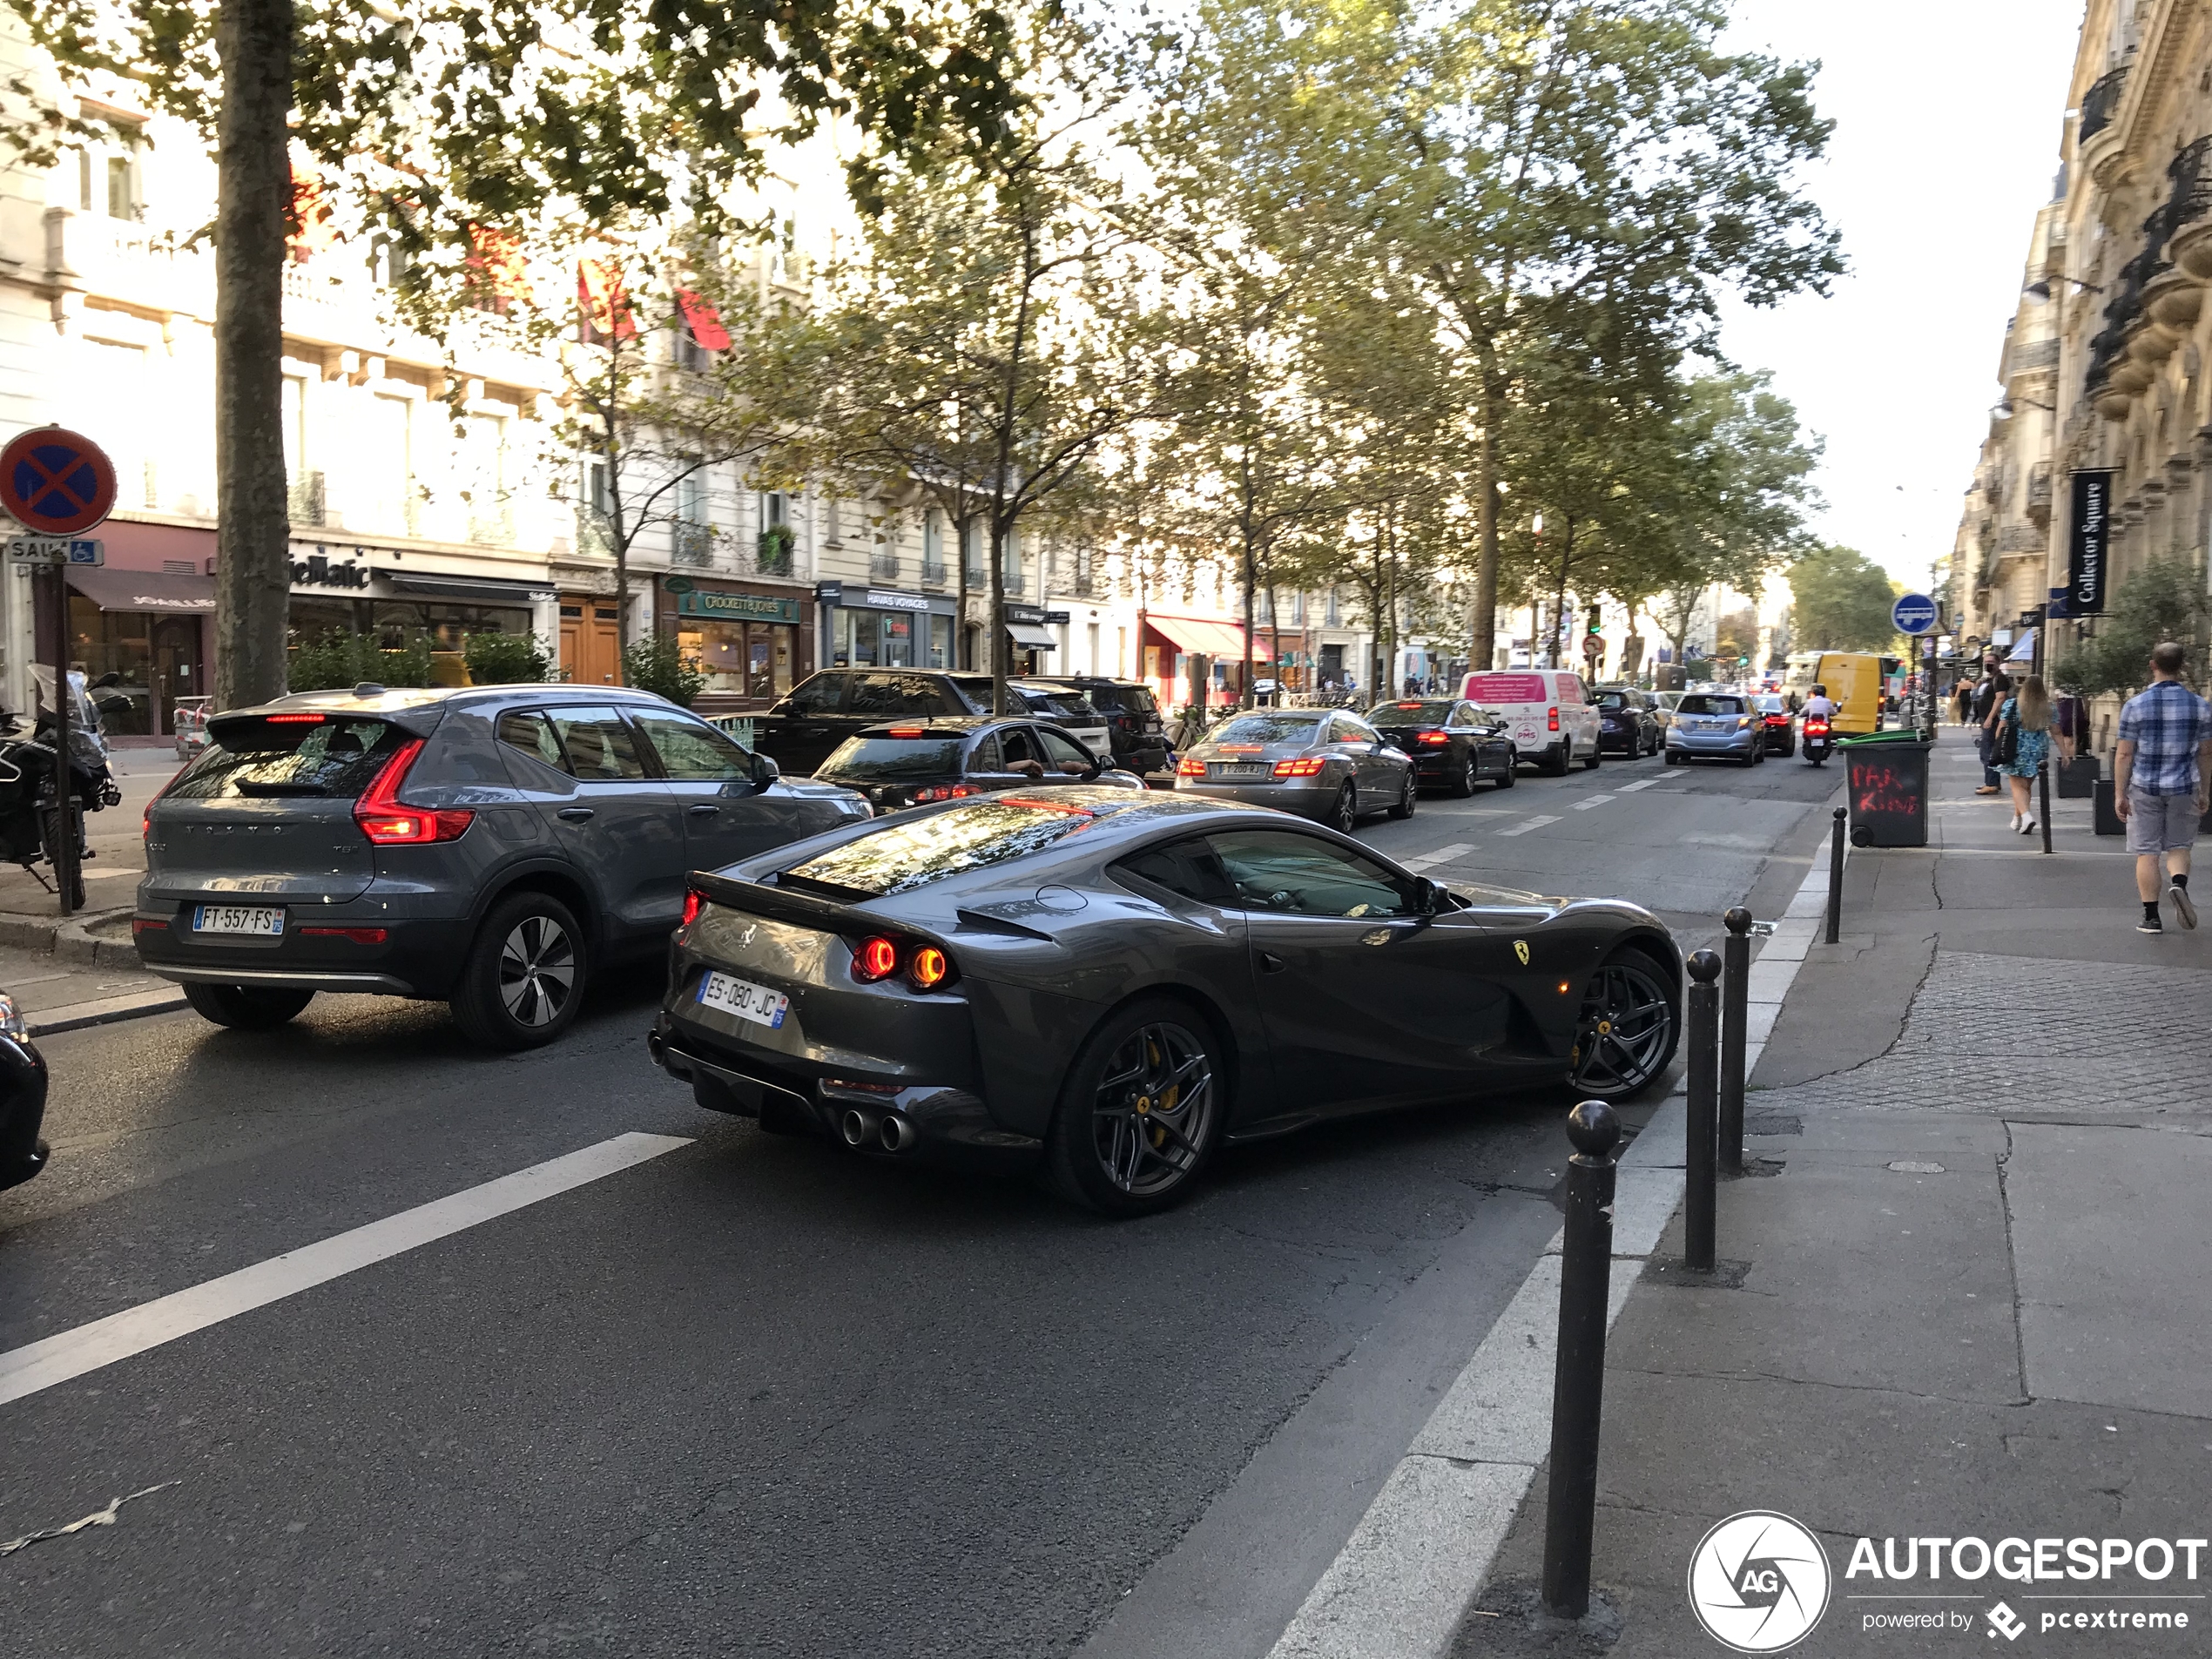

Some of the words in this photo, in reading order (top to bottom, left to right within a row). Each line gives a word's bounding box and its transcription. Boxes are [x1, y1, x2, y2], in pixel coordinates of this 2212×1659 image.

[2081, 482, 2104, 533] Square
[11, 541, 67, 557] SAU
[288, 553, 369, 590] ieMatic
[2078, 536, 2099, 603] Collector
[867, 594, 894, 606] HAVAS
[894, 597, 930, 610] VOYAGES
